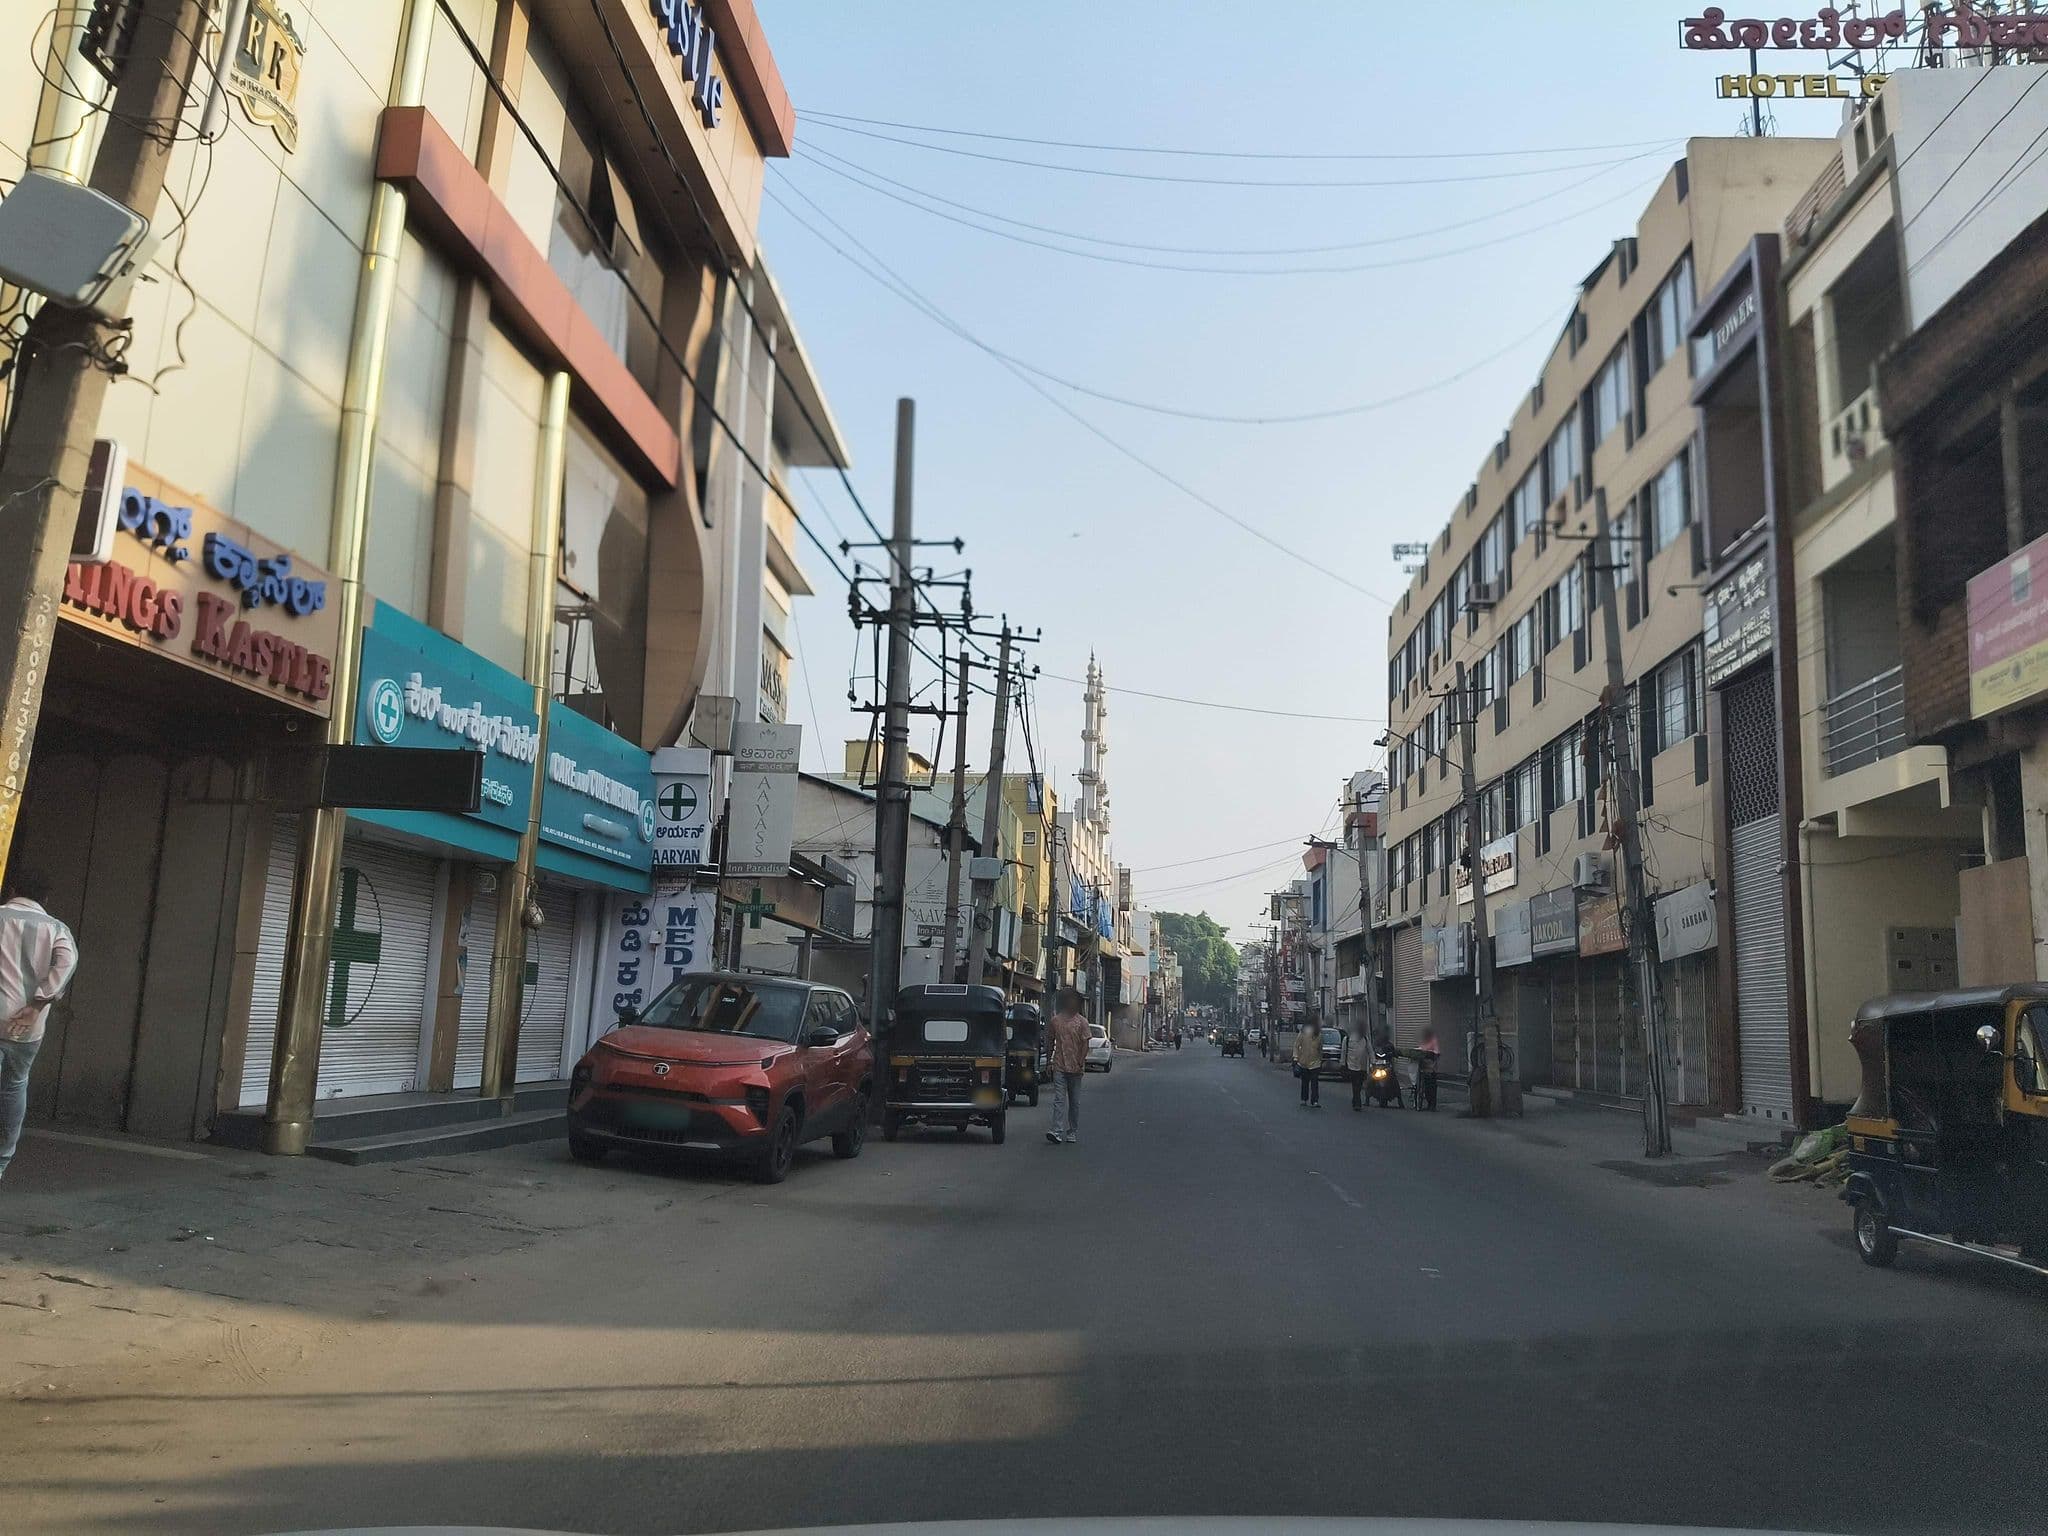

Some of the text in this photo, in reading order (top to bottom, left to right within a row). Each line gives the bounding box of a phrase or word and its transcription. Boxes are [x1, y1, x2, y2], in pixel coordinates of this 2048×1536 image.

[1684, 7, 1903, 49] ಹೋಟೆಲ್
[1722, 75, 1850, 98] HOTEL
[191, 591, 331, 701] KASTLE
[549, 752, 577, 789] CARE
[653, 849, 700, 864] AARYAN
[728, 863, 743, 873] Inn
[1682, 910, 1708, 929] SANGAM
